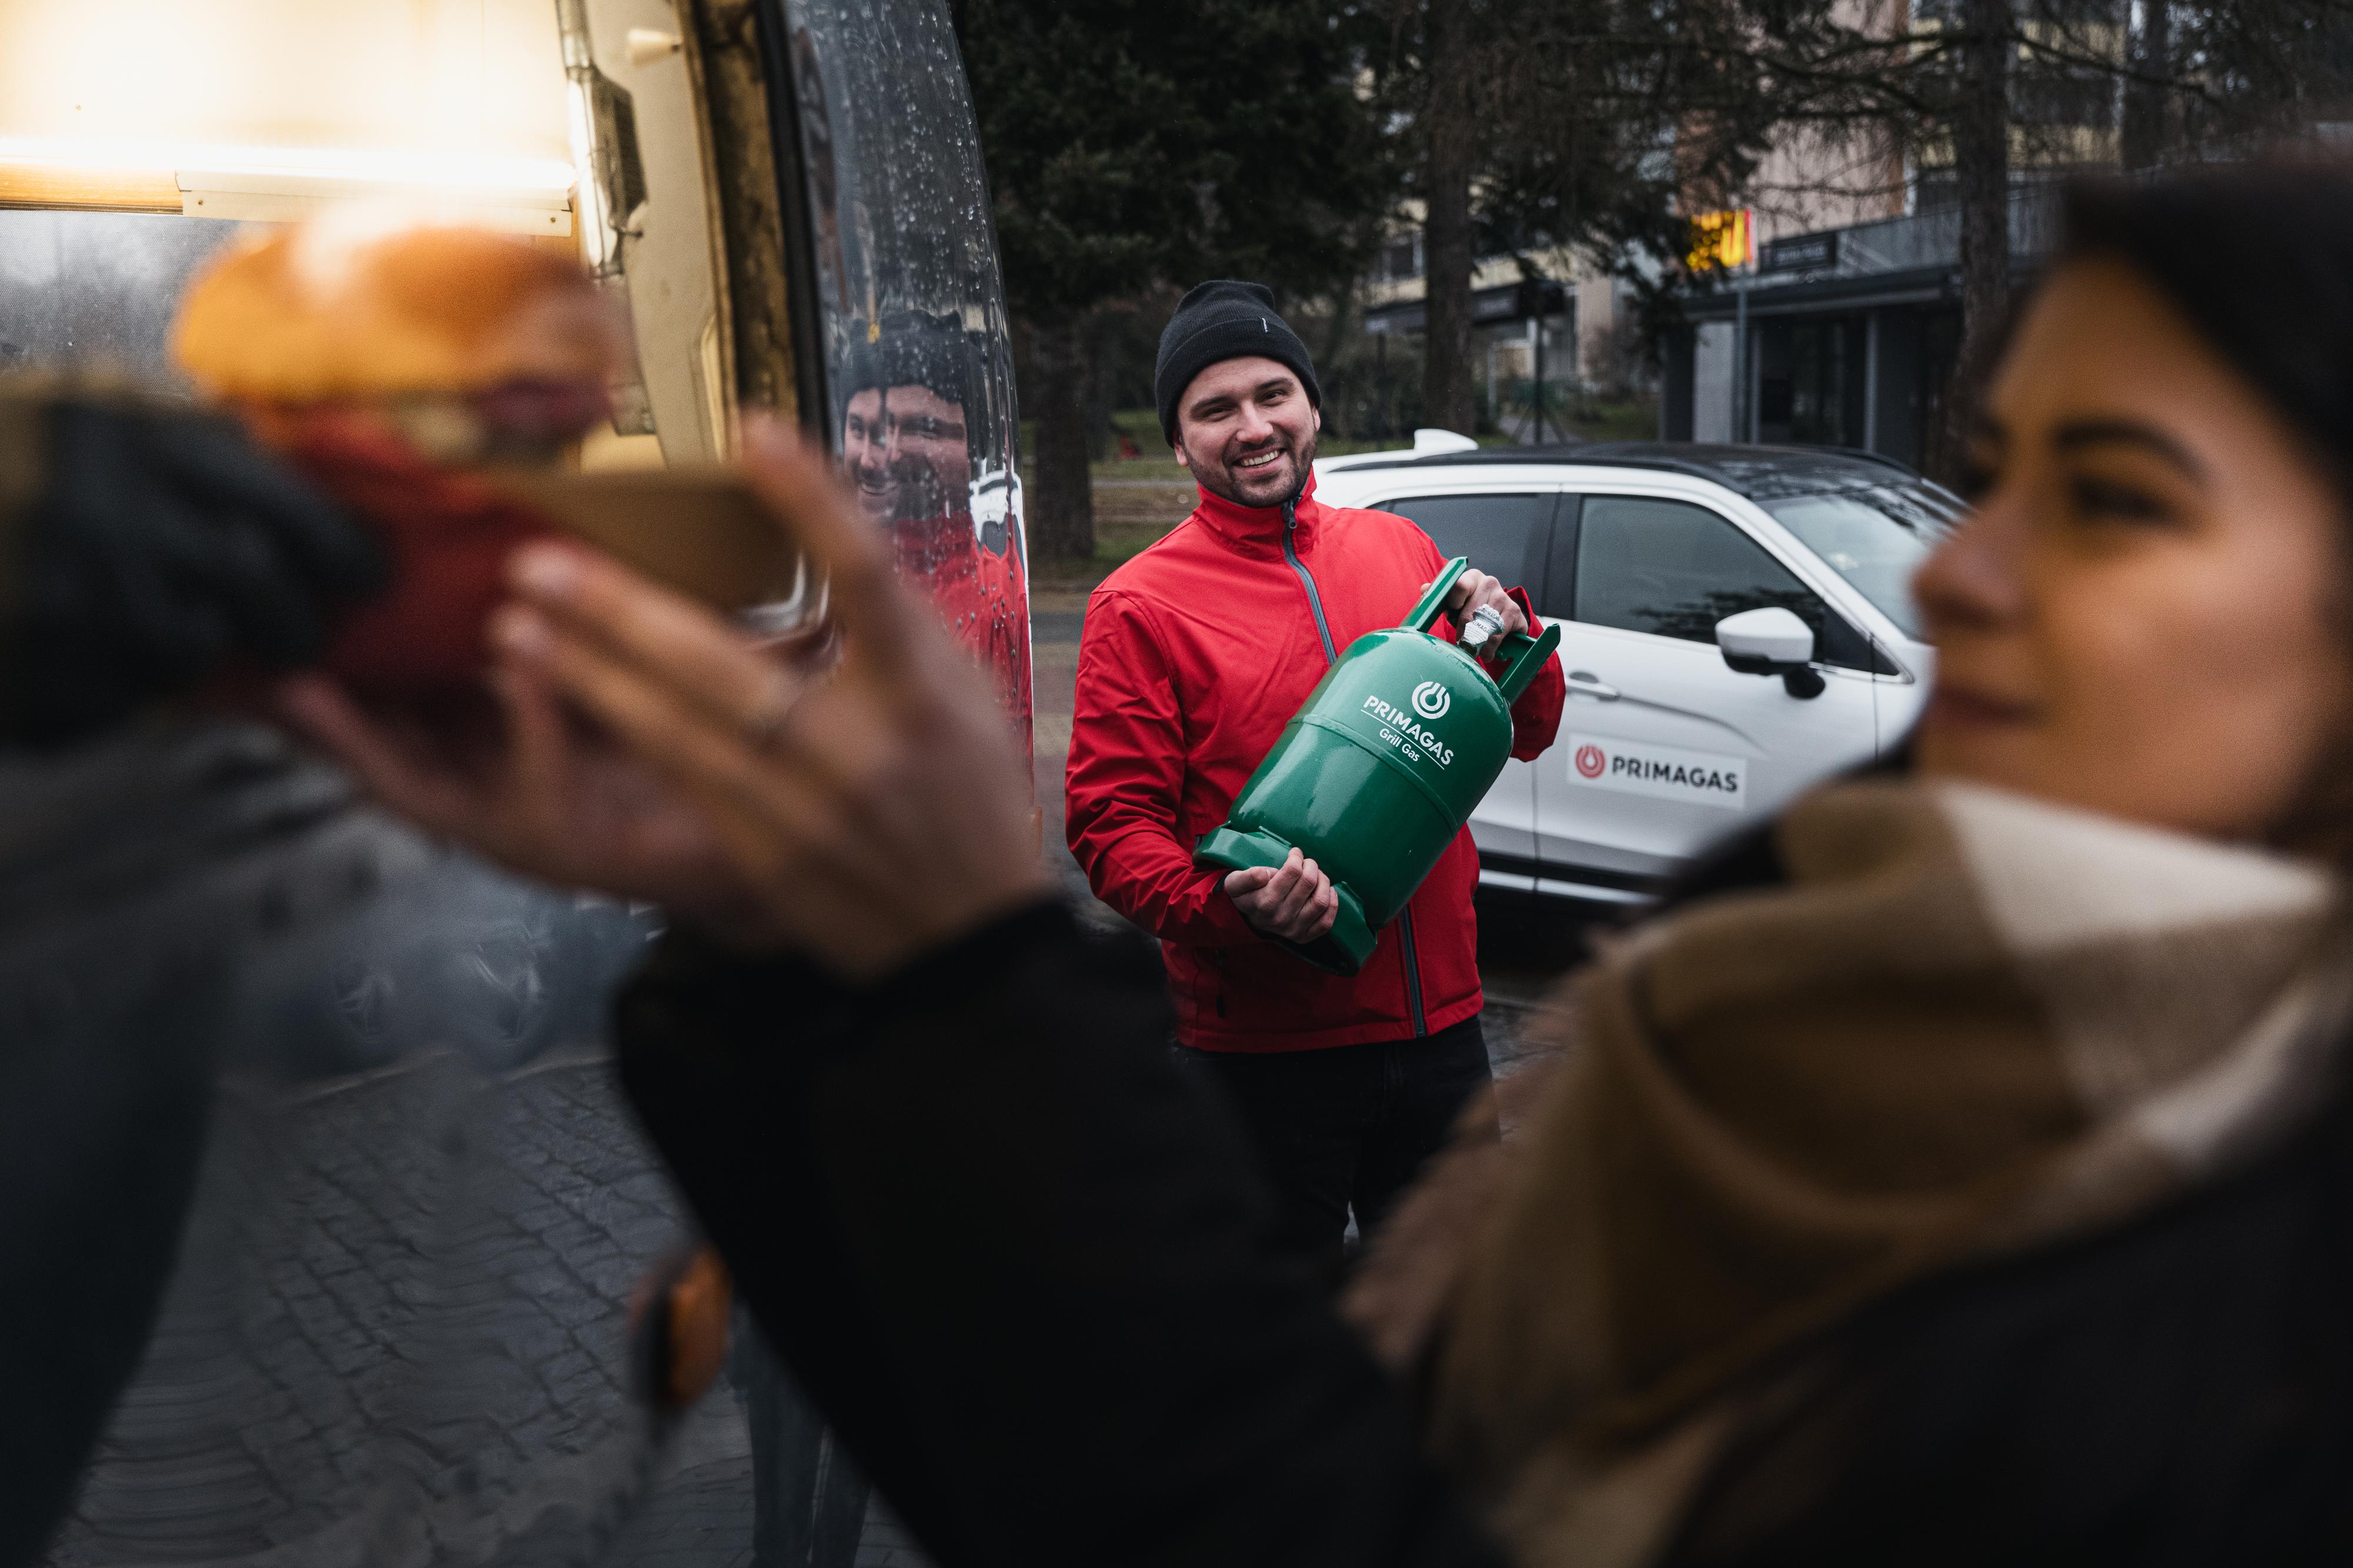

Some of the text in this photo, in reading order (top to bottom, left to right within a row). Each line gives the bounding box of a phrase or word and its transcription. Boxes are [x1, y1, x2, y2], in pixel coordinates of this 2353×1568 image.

[1363, 695, 1454, 765] PRIMAGAS
[1379, 728, 1420, 762] Grill Gas
[1612, 756, 1738, 793] PRIMAGAS
